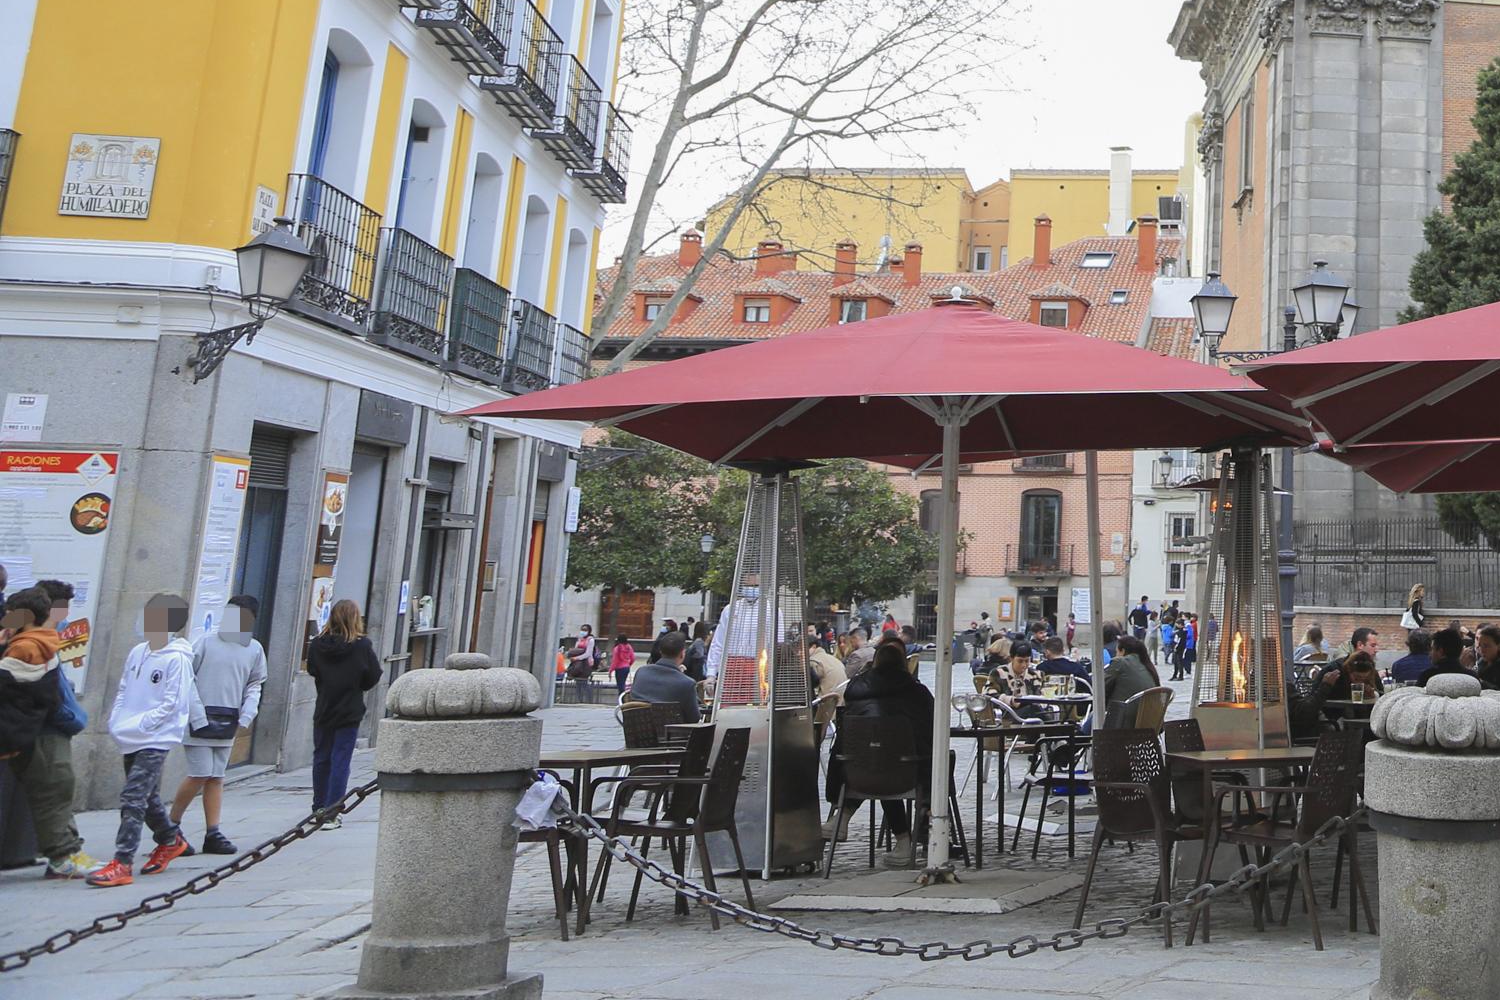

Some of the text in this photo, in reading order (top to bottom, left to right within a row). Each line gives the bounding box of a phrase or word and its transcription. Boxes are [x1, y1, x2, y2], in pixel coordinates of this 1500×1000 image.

[66, 183, 146, 197] PLAZA DEL
[60, 196, 149, 215] HUMILLADERO
[7, 456, 61, 466] RACIONES
